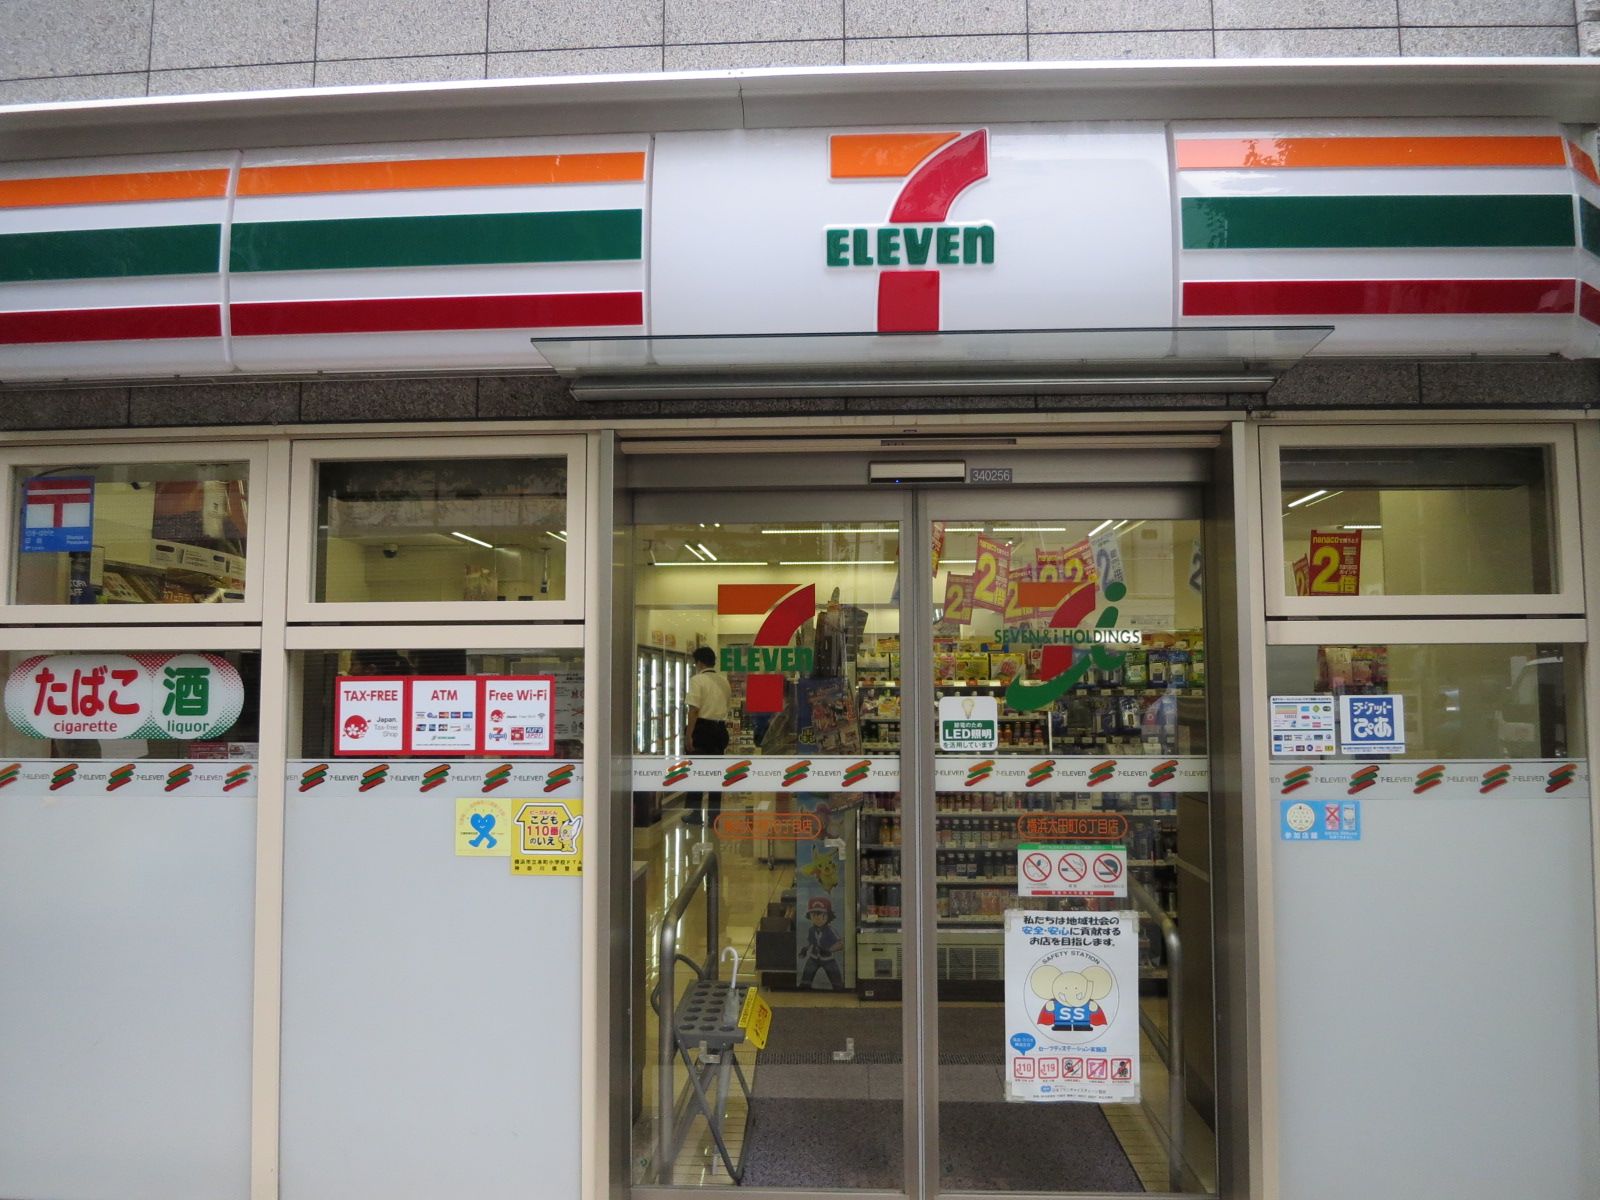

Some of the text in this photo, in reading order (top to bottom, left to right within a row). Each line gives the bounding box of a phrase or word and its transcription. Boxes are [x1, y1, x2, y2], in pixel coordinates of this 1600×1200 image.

[972, 470, 1010, 481] 340256
[1311, 546, 1340, 592] 2
[1063, 629, 1141, 644] HOLDINGS
[34, 666, 210, 716] たばこ 酒
[344, 689, 398, 701] TAX-FREE
[431, 689, 458, 701] ATM
[489, 689, 514, 700] Free
[517, 689, 547, 700] Wi-Fi
[1352, 701, 1392, 714] チケット
[54, 720, 209, 735] cigarette liquor
[1353, 717, 1392, 738] ぴあ
[945, 728, 992, 740] LED照明
[530, 816, 559, 825] こども
[527, 826, 560, 837] 110番
[529, 836, 555, 846] のいえ
[1023, 915, 1120, 926] 私たちは地域社会の
[1029, 937, 1116, 947] お店を目指します。
[1042, 950, 1100, 965] SAFETY STATION
[1059, 1007, 1085, 1021] SS
